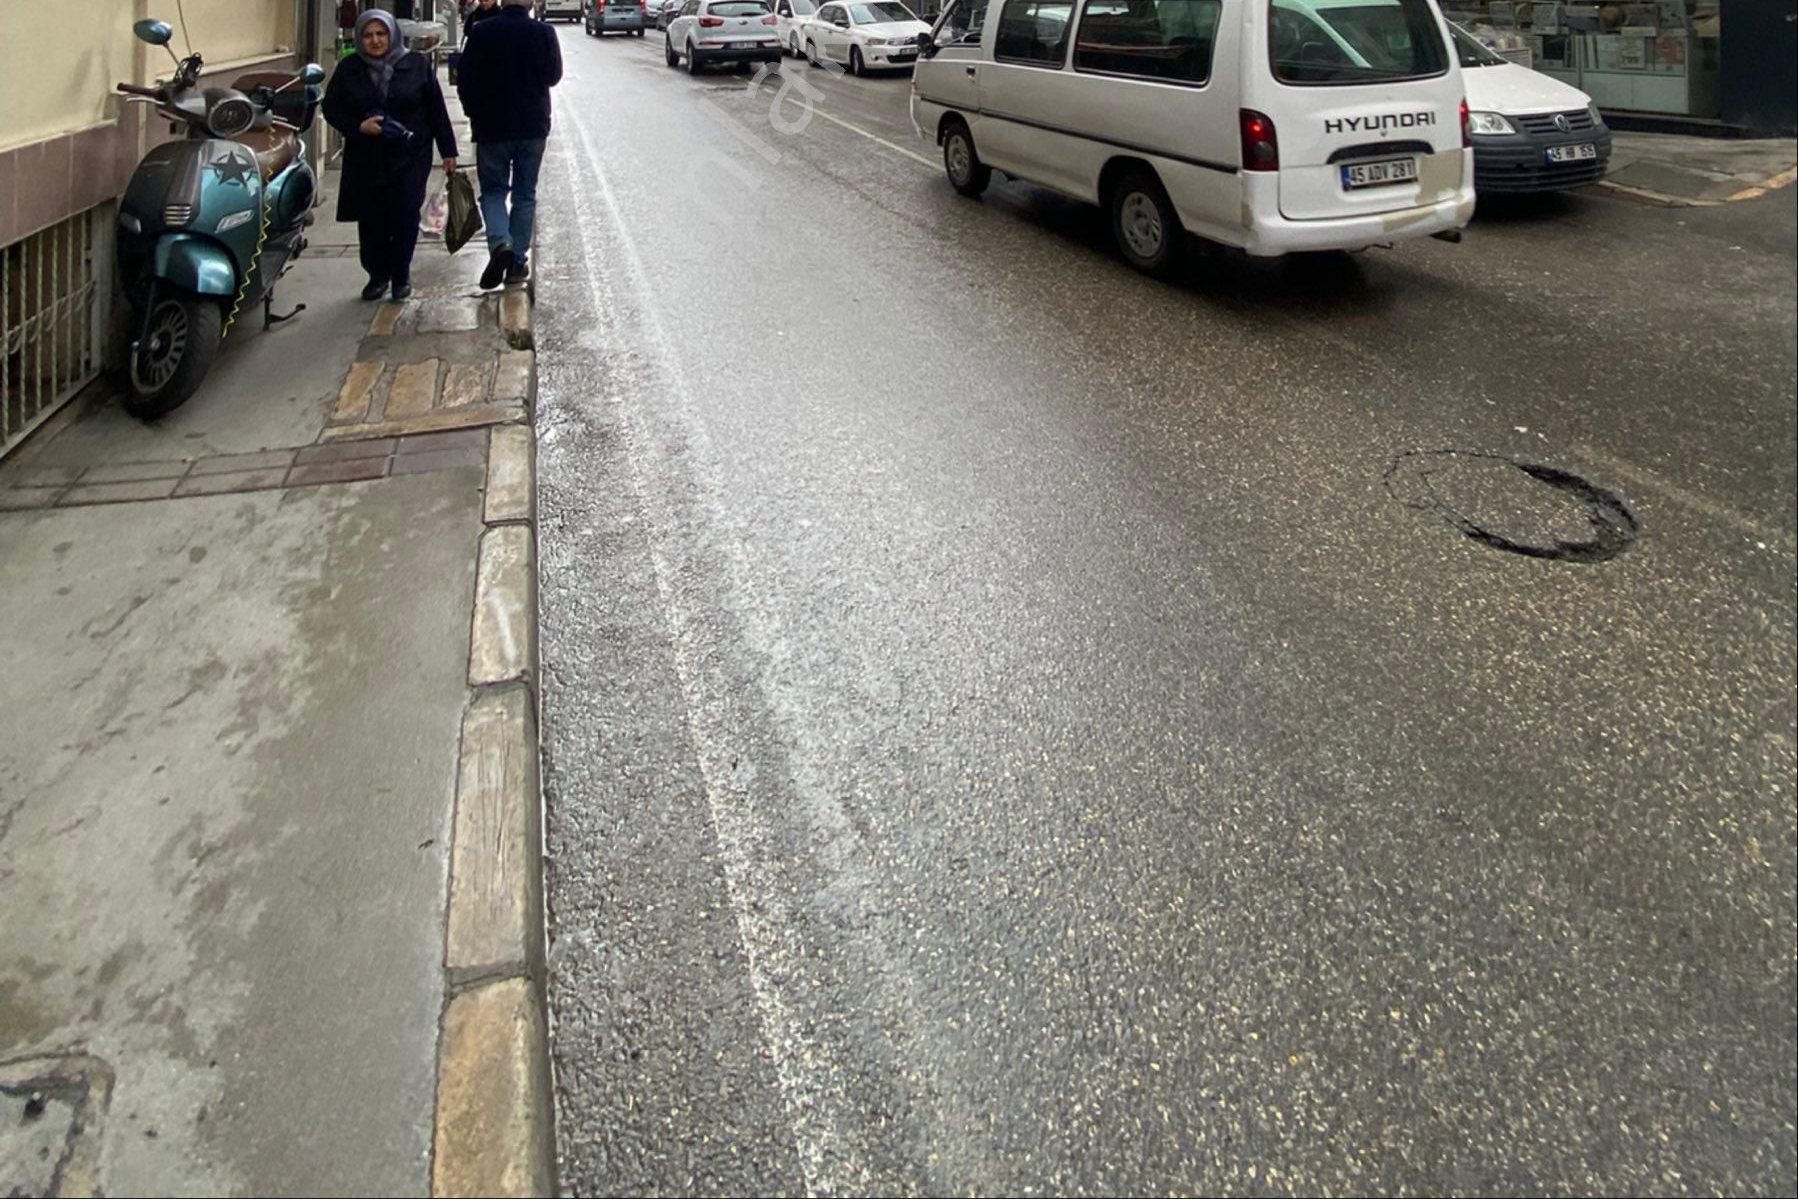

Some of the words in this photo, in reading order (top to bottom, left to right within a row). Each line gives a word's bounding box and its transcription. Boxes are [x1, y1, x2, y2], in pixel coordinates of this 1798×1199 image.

[1324, 111, 1436, 134] HYUNDAI
[1350, 166, 1366, 183] 45
[1391, 162, 1413, 179] 281
